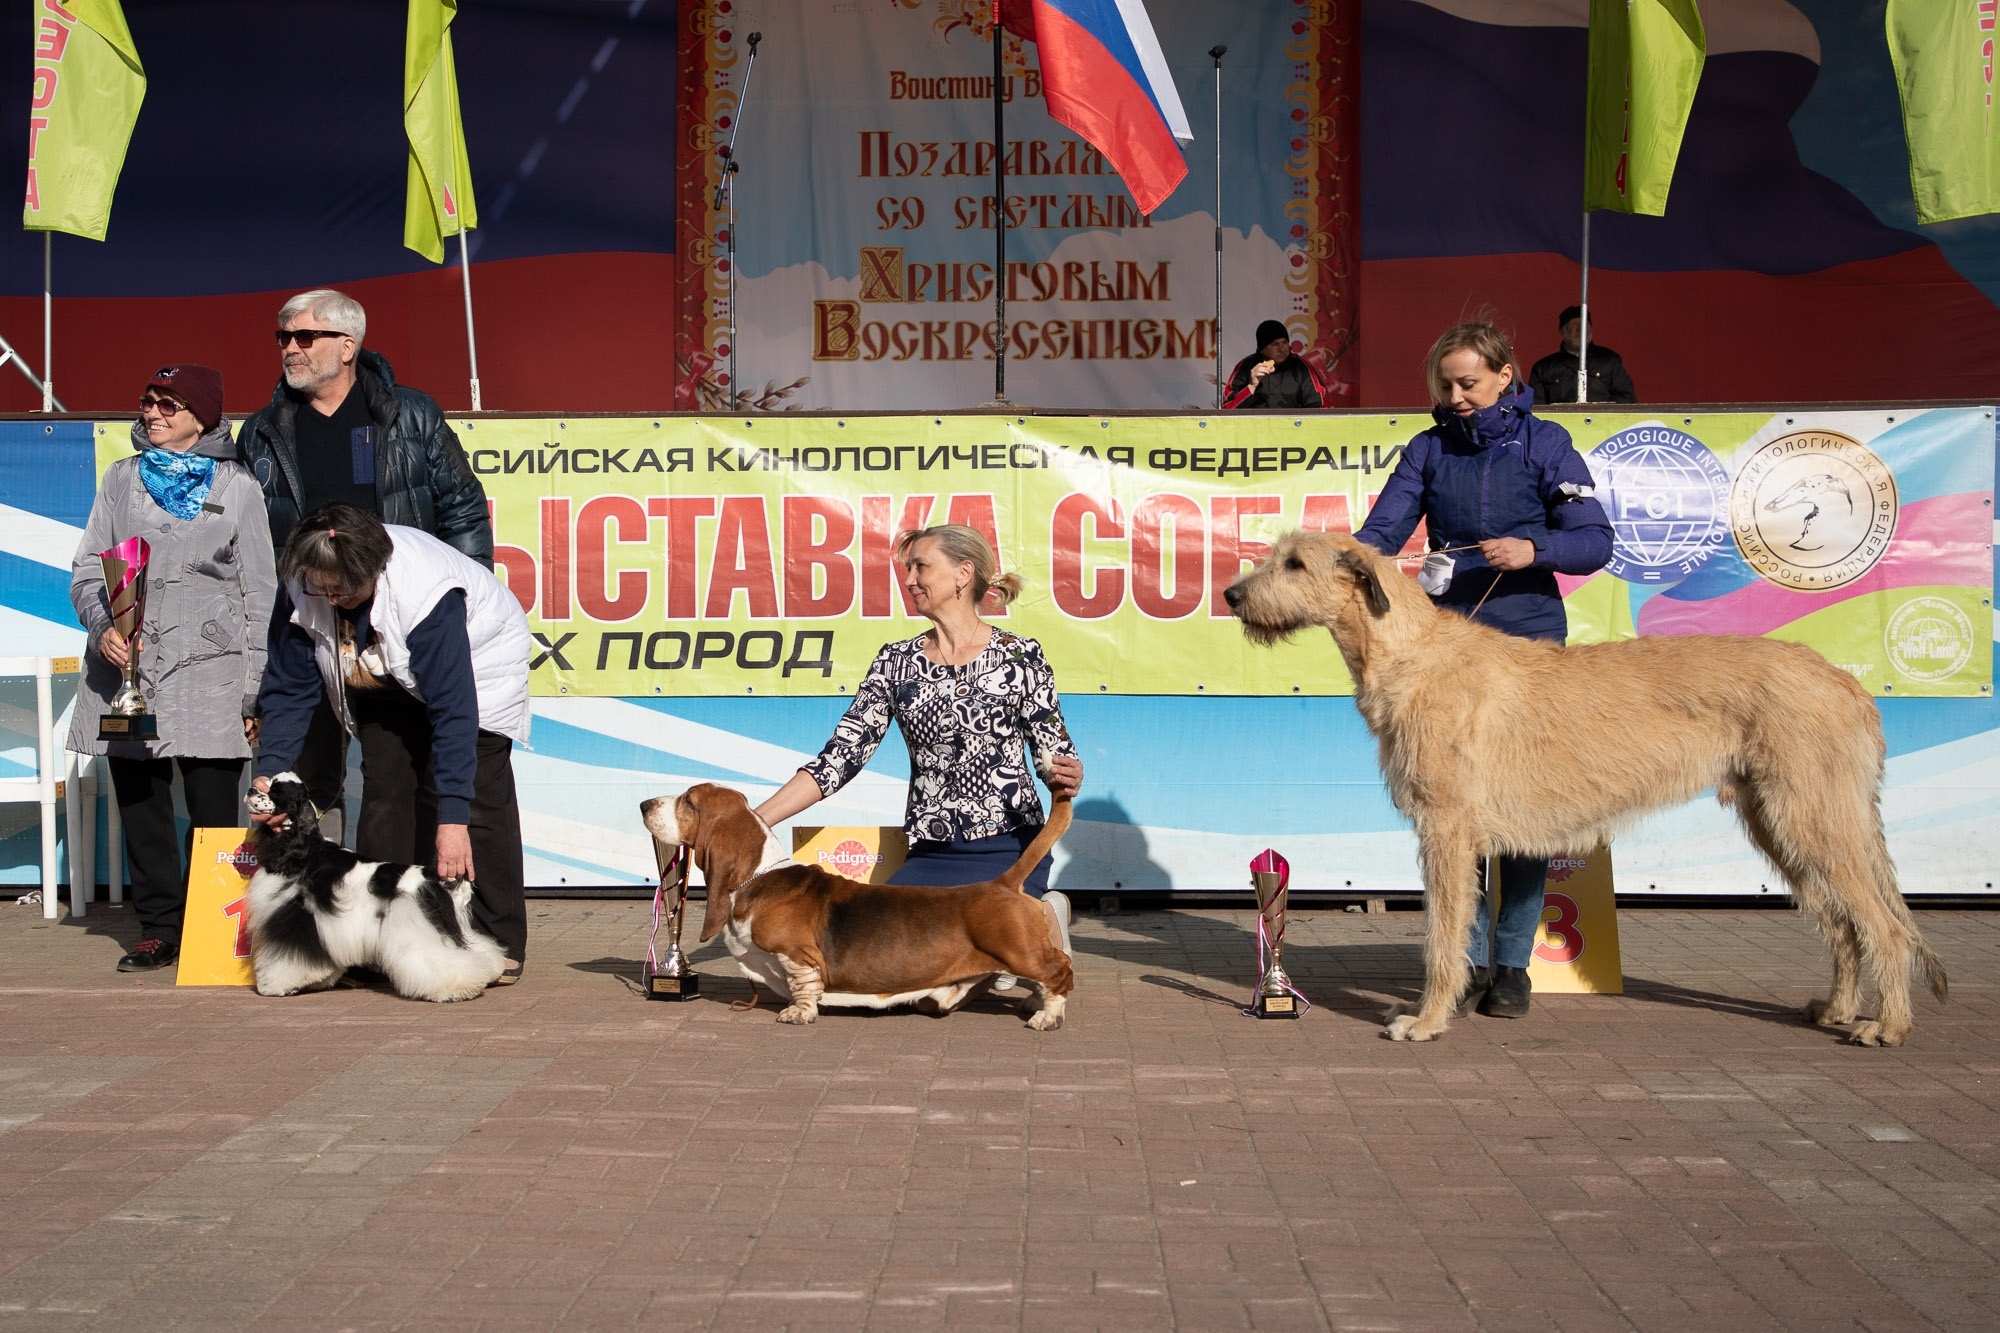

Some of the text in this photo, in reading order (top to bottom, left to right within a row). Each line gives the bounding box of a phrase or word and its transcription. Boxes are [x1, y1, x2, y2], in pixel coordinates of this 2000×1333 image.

[889, 70, 1014, 103] Воистину
[857, 131, 1124, 178] ПОЗДРАВЛЯ
[876, 195, 925, 230] СО
[464, 442, 694, 475] СИЙСКАЯ
[707, 443, 1134, 473] КИНОЛОГИЧЕСКАЯ
[1620, 490, 1684, 520] FCI
[1823, 501, 1891, 584] ФЕДЕРАЦИЯ
[595, 630, 834, 677] ПОРОД
[816, 851, 884, 866] Pedigree
[222, 894, 255, 958] 1
[1532, 891, 1585, 965] 3
